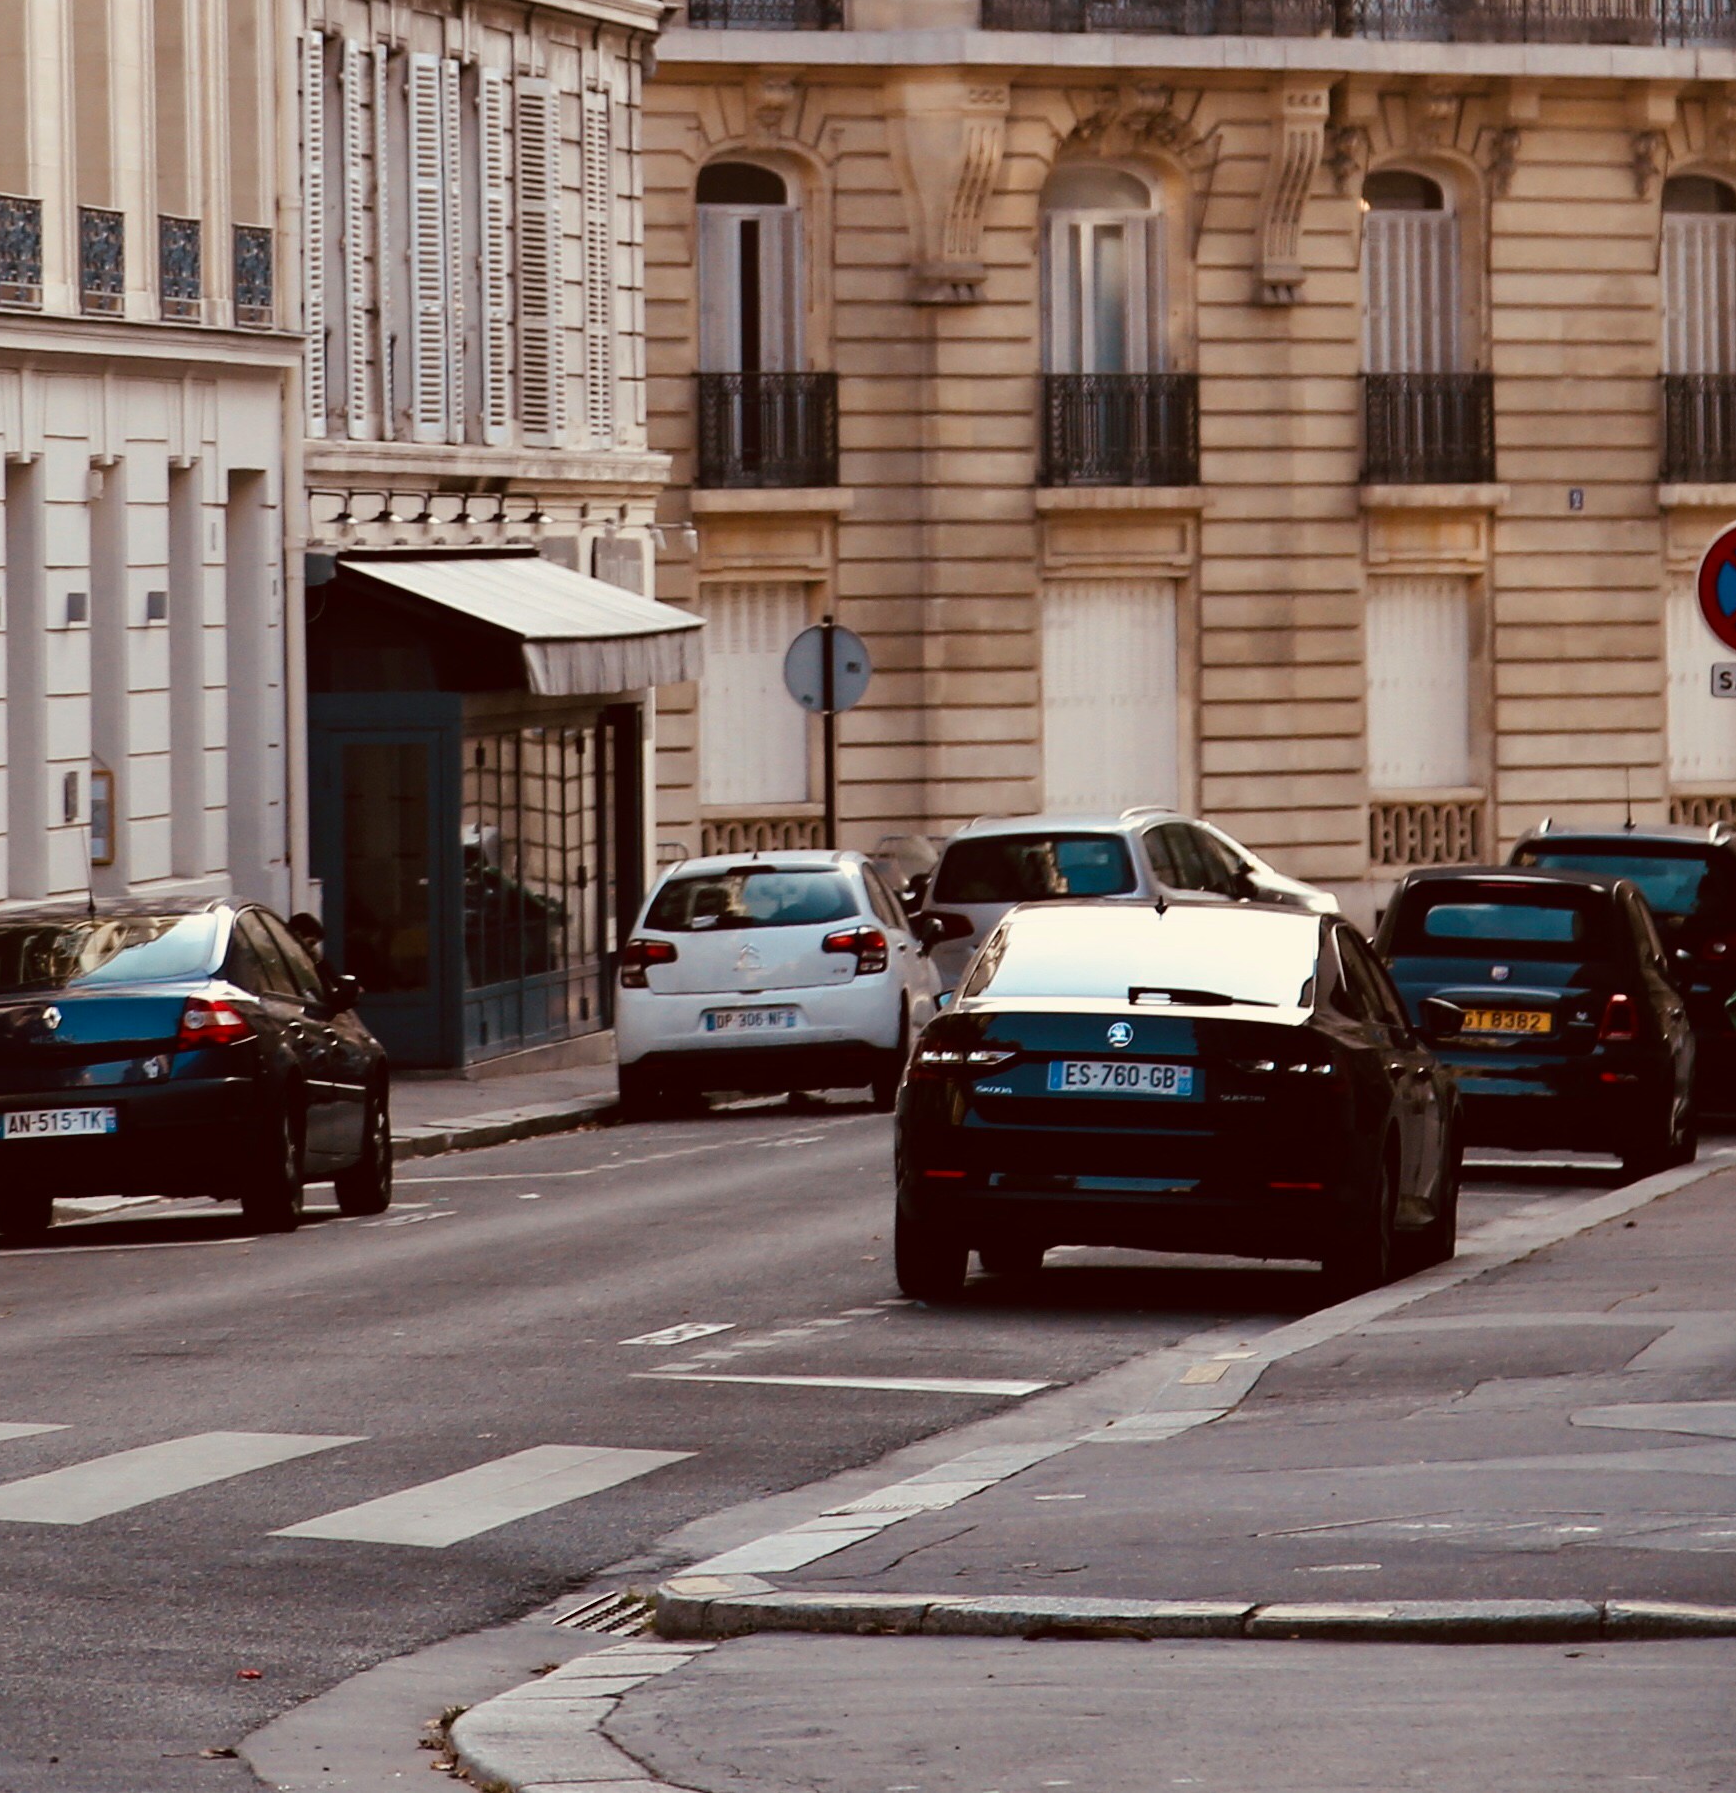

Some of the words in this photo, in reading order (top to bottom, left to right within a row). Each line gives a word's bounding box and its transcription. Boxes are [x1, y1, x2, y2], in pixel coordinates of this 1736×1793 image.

[1491, 1012, 1541, 1029] 8382
[1065, 1063, 1176, 1089] ES-760-GB
[7, 1110, 102, 1134] AN-515-TK
